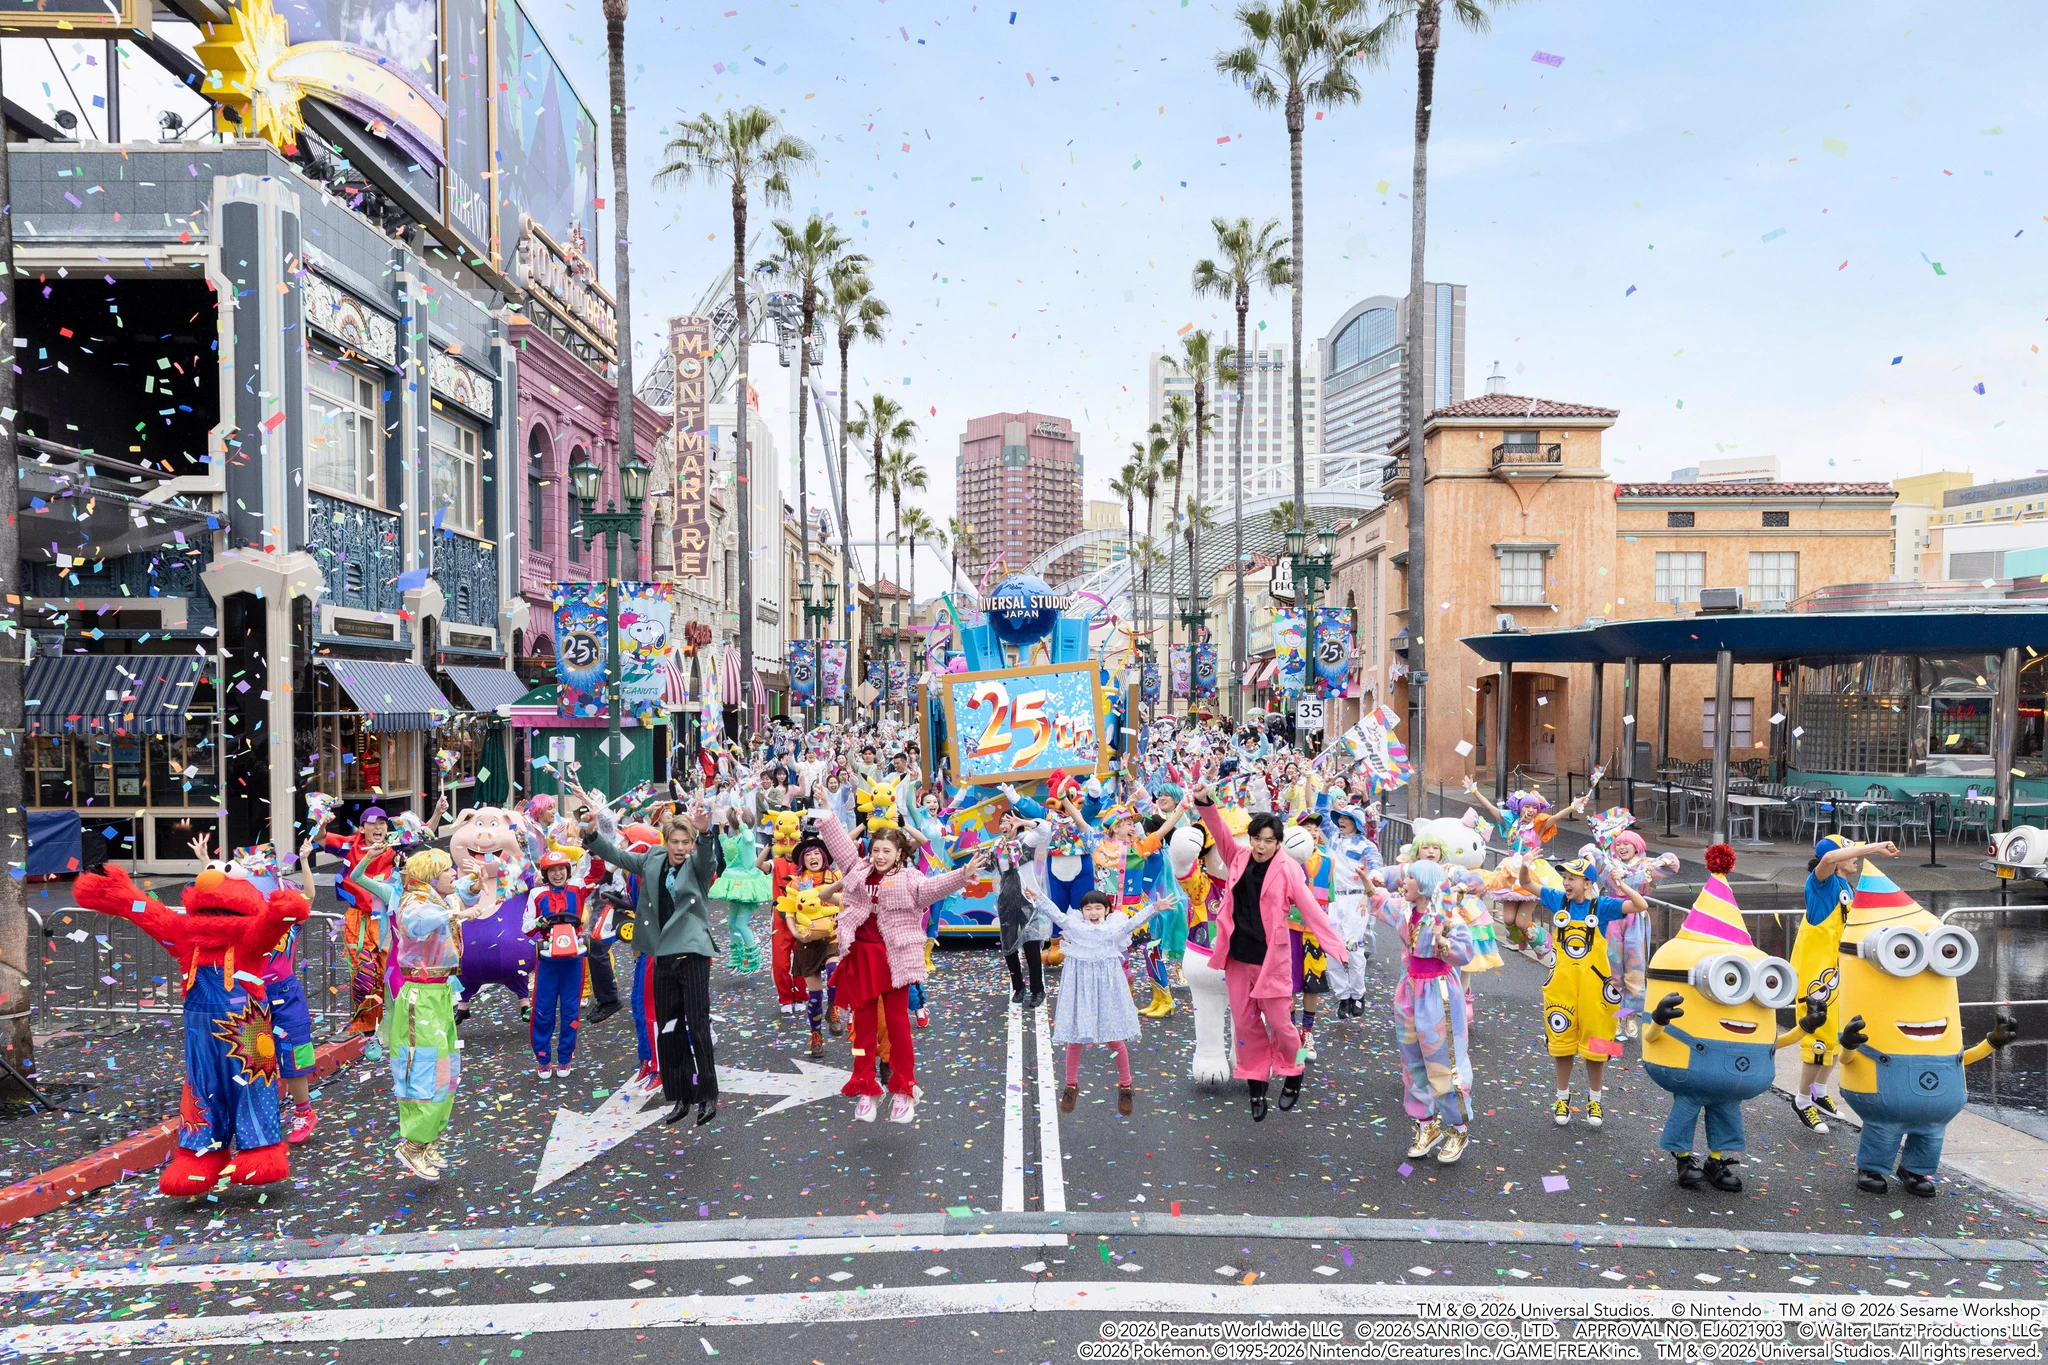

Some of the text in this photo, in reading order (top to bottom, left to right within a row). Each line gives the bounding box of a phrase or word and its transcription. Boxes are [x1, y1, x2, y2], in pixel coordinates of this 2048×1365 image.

[678, 333, 703, 573] MONTMARTRE
[1960, 489, 1990, 500] HOTEL
[1275, 581, 1294, 591] PHO
[979, 595, 1073, 612] NIVERSAL STUDIOS
[1005, 610, 1039, 618] JAPAN
[1299, 703, 1322, 718] 35
[967, 682, 1093, 769] 25th
